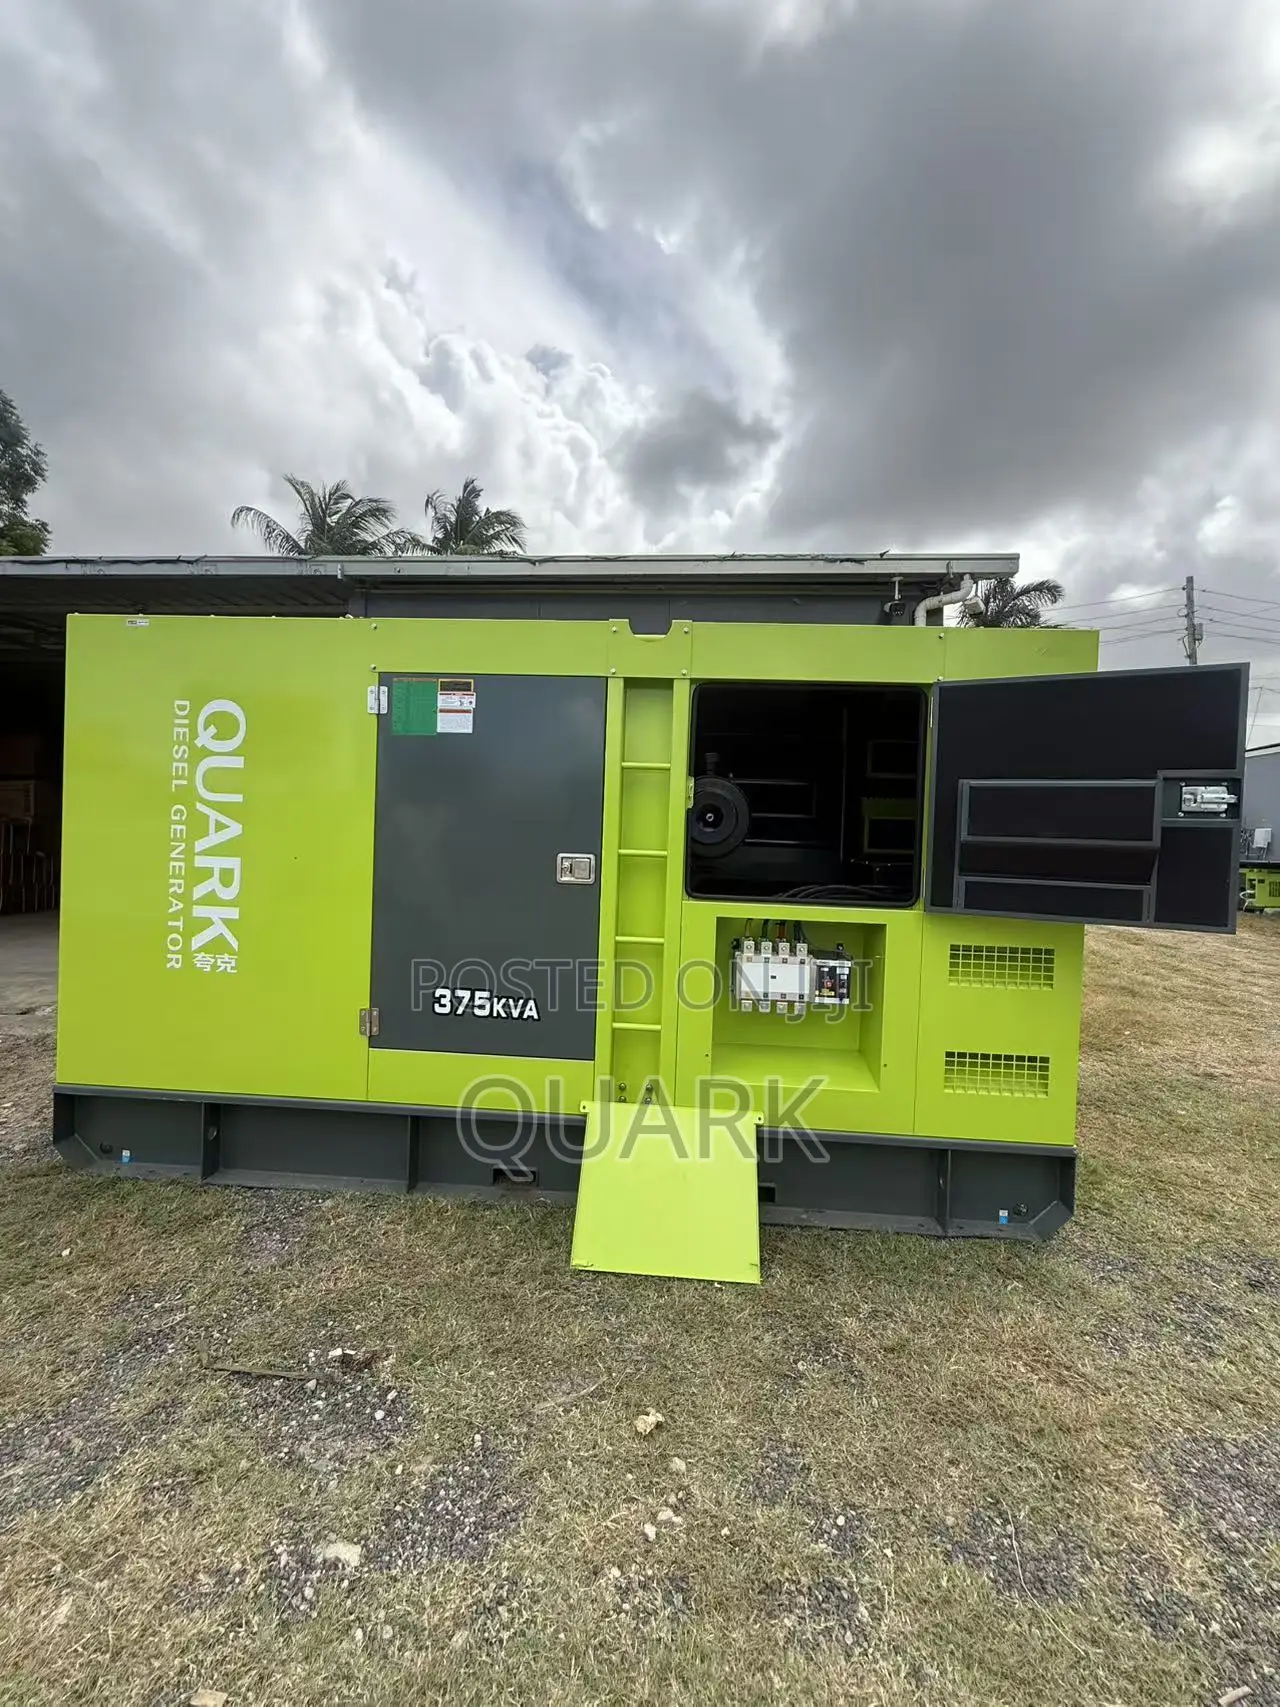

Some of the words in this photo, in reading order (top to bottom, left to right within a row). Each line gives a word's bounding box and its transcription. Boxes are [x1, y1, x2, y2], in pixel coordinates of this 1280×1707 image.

[171, 700, 190, 792] DIESEL
[192, 698, 247, 952] QUARK
[166, 804, 187, 969] GENERATOR
[192, 951, 239, 973] 夸克
[433, 987, 540, 1020] 375KVA
